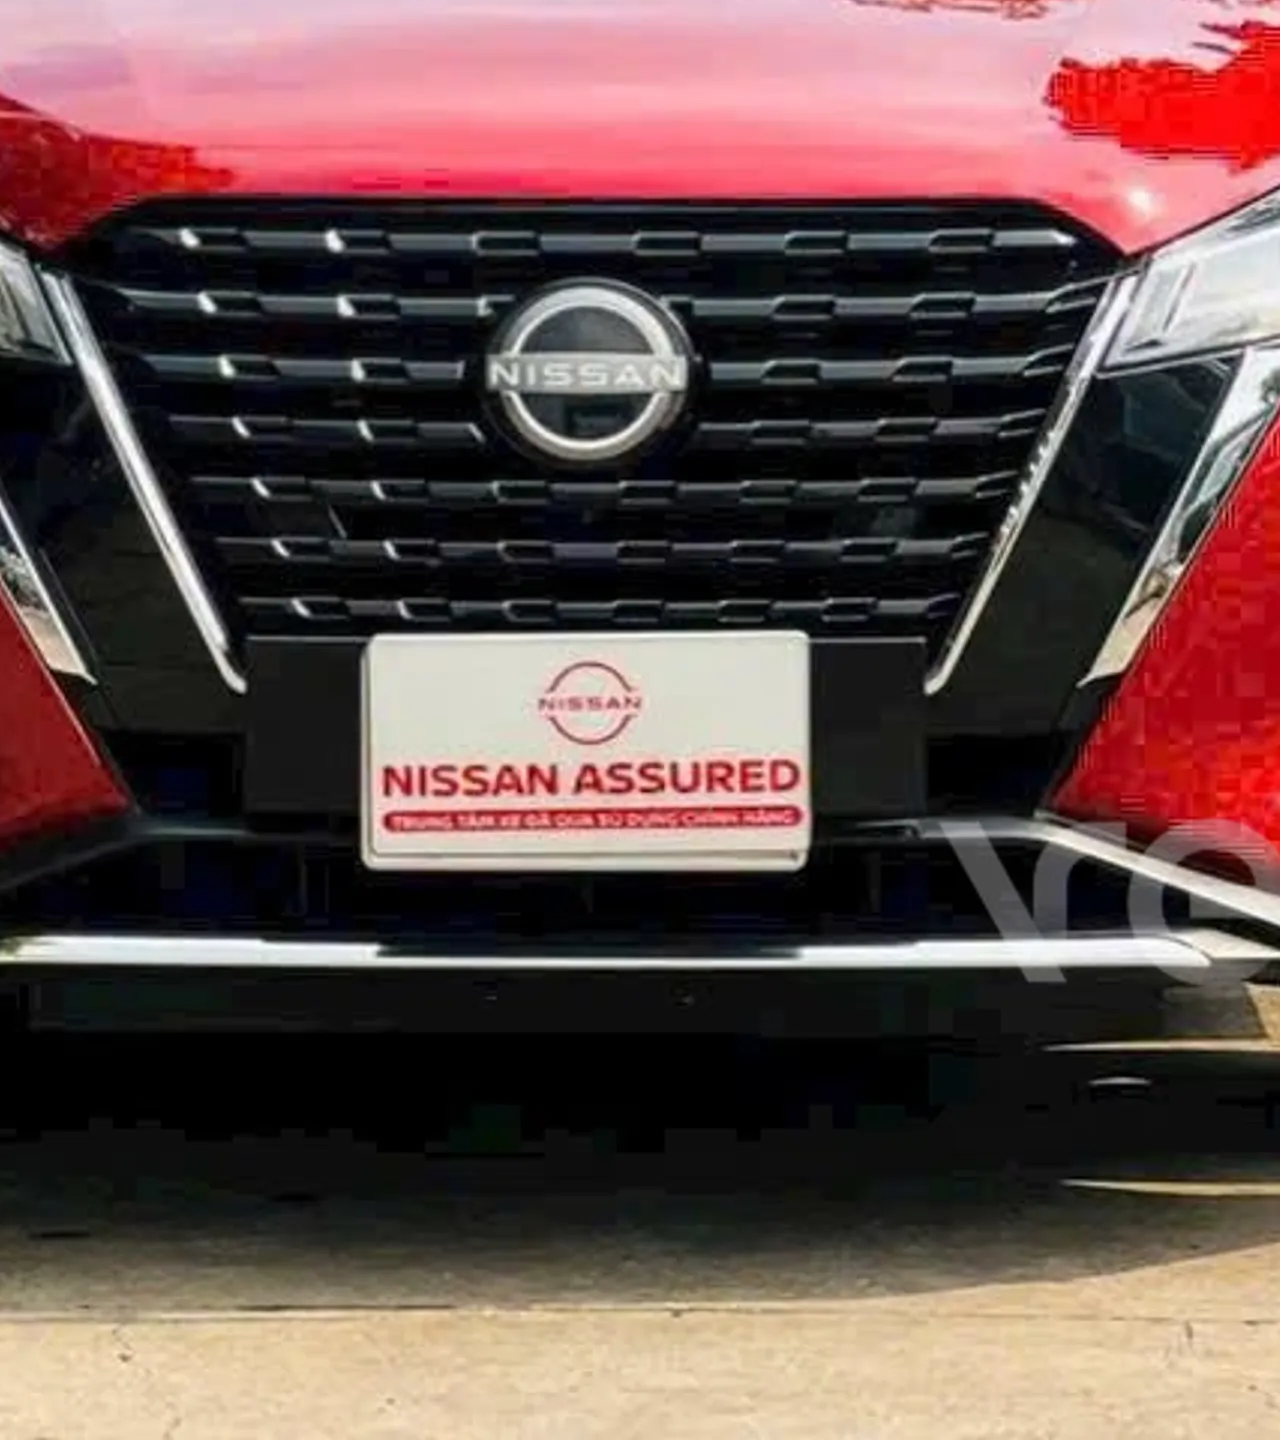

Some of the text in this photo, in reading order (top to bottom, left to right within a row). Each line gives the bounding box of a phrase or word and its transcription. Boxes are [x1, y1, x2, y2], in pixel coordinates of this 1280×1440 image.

[488, 362, 682, 388] NISSAN
[537, 695, 642, 712] NISSAN
[382, 759, 801, 797] NISSAN ASSURED
